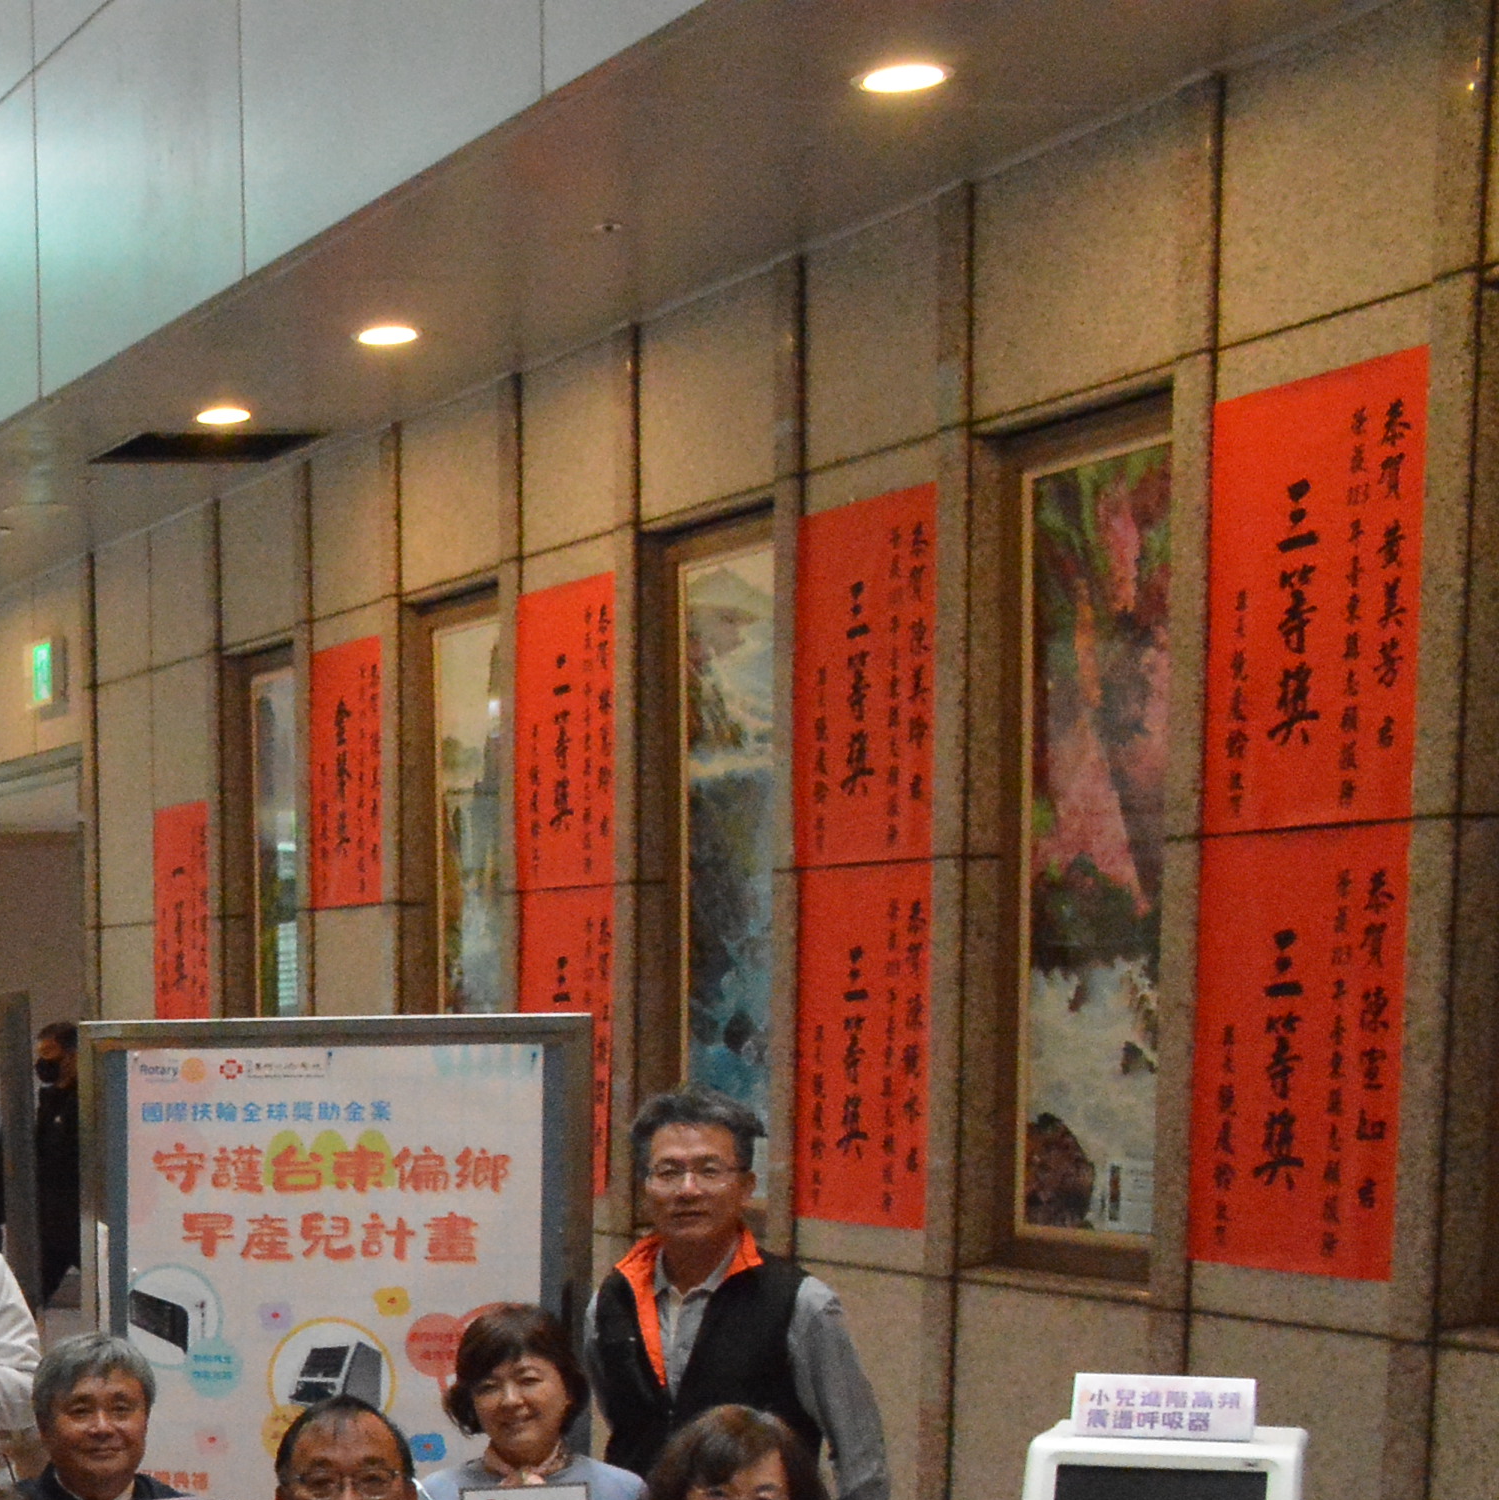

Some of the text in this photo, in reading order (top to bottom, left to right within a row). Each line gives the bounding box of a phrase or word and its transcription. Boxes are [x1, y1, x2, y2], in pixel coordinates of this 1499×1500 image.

[1378, 399, 1410, 500] 恭賀
[1267, 479, 1320, 747] 三等獎
[840, 580, 875, 797] 三等獎
[1358, 869, 1396, 969] 恭賀
[140, 1064, 178, 1078] Rotary
[836, 946, 870, 1159] 三等獎
[1254, 929, 1304, 1192] 三等獎
[142, 1100, 393, 1123] 國際扶輪全球獎助金案
[152, 1142, 511, 1195] 守護台東偏鄉
[181, 1211, 479, 1264] 早產兒計畫
[1086, 1410, 1212, 1432] 震盪呼吸器
[1088, 1387, 1242, 1410] 小兒進階高頻
